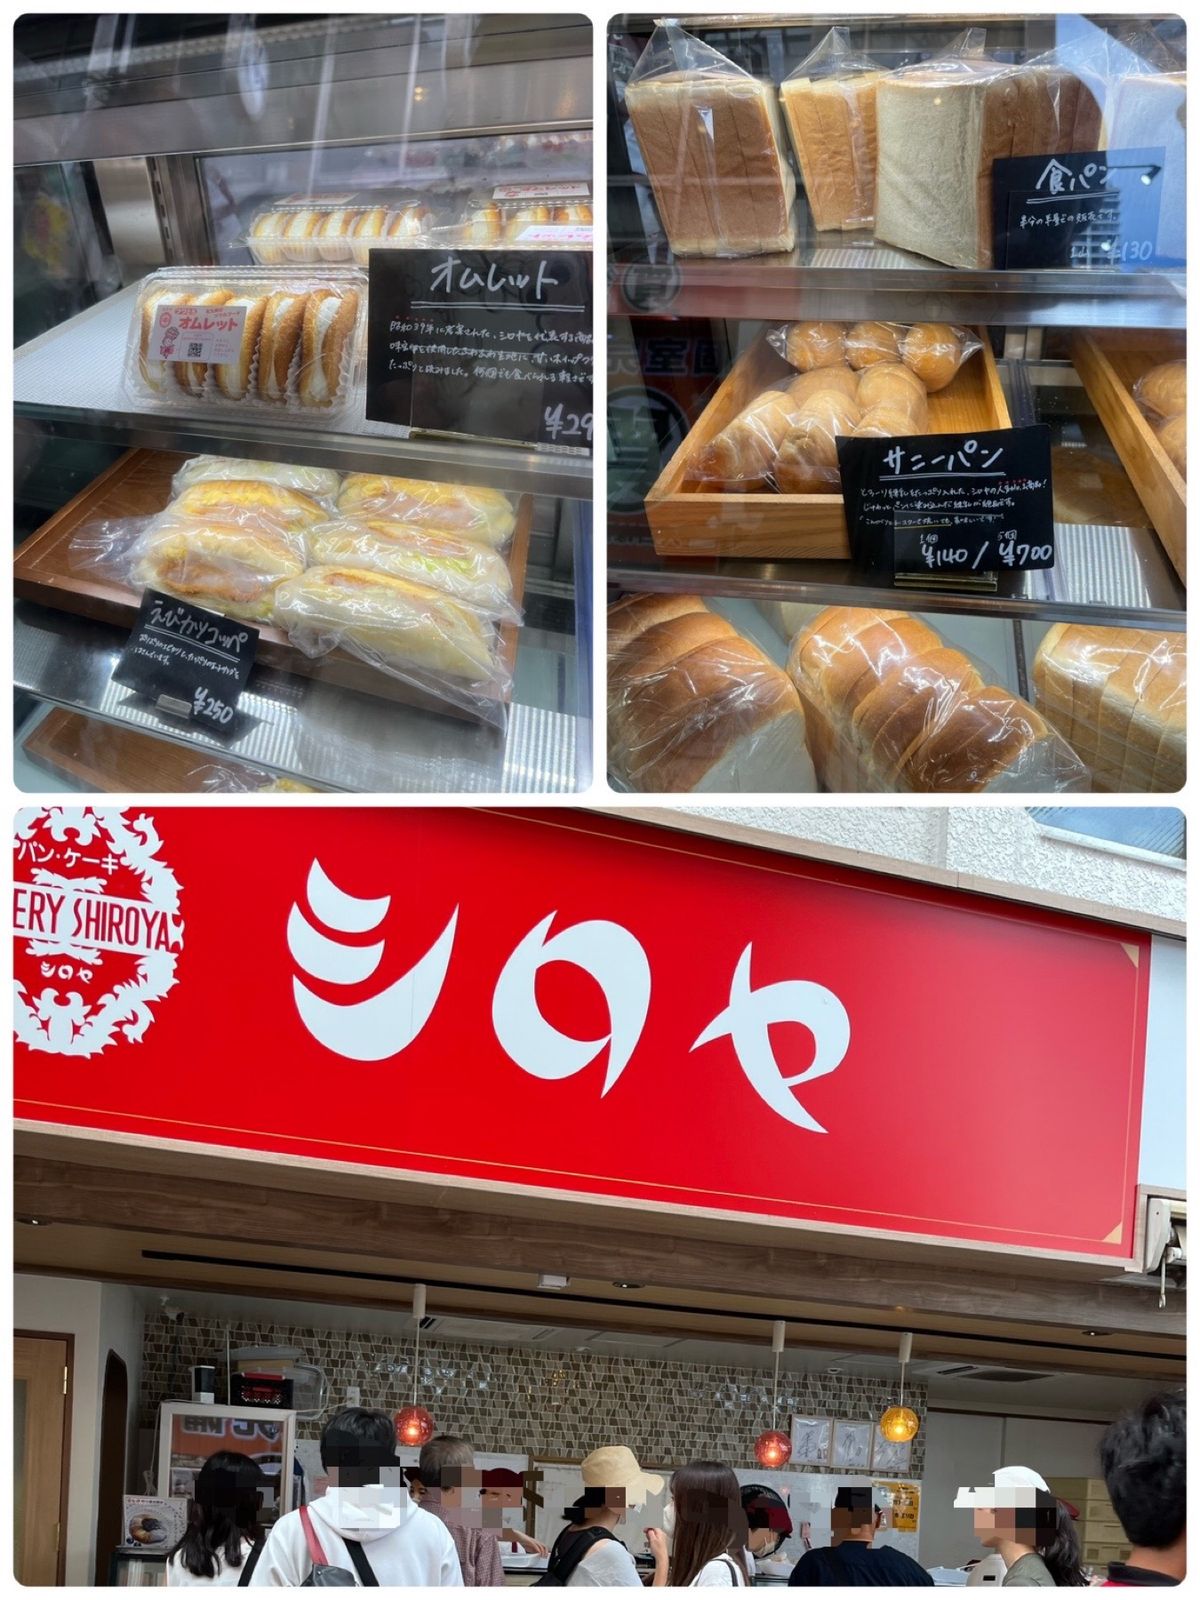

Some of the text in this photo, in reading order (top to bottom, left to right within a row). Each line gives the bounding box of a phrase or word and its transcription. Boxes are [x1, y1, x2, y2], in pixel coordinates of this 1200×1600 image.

[1035, 158, 1118, 195] 食パン
[430, 256, 559, 300] オムレット
[179, 316, 238, 331] オムレット
[544, 403, 593, 441] ¥29
[882, 440, 1004, 474] サニーパン
[921, 543, 968, 568] ¥140
[999, 540, 1052, 566] ¥700
[150, 600, 249, 653] えびカツコッペ
[193, 686, 234, 724] ¥250
[17, 841, 119, 875] パン・ケーキ
[13, 888, 171, 951] ERY SHIROYA
[40, 961, 94, 984] シロヤ
[287, 858, 851, 1133] シロヤ
